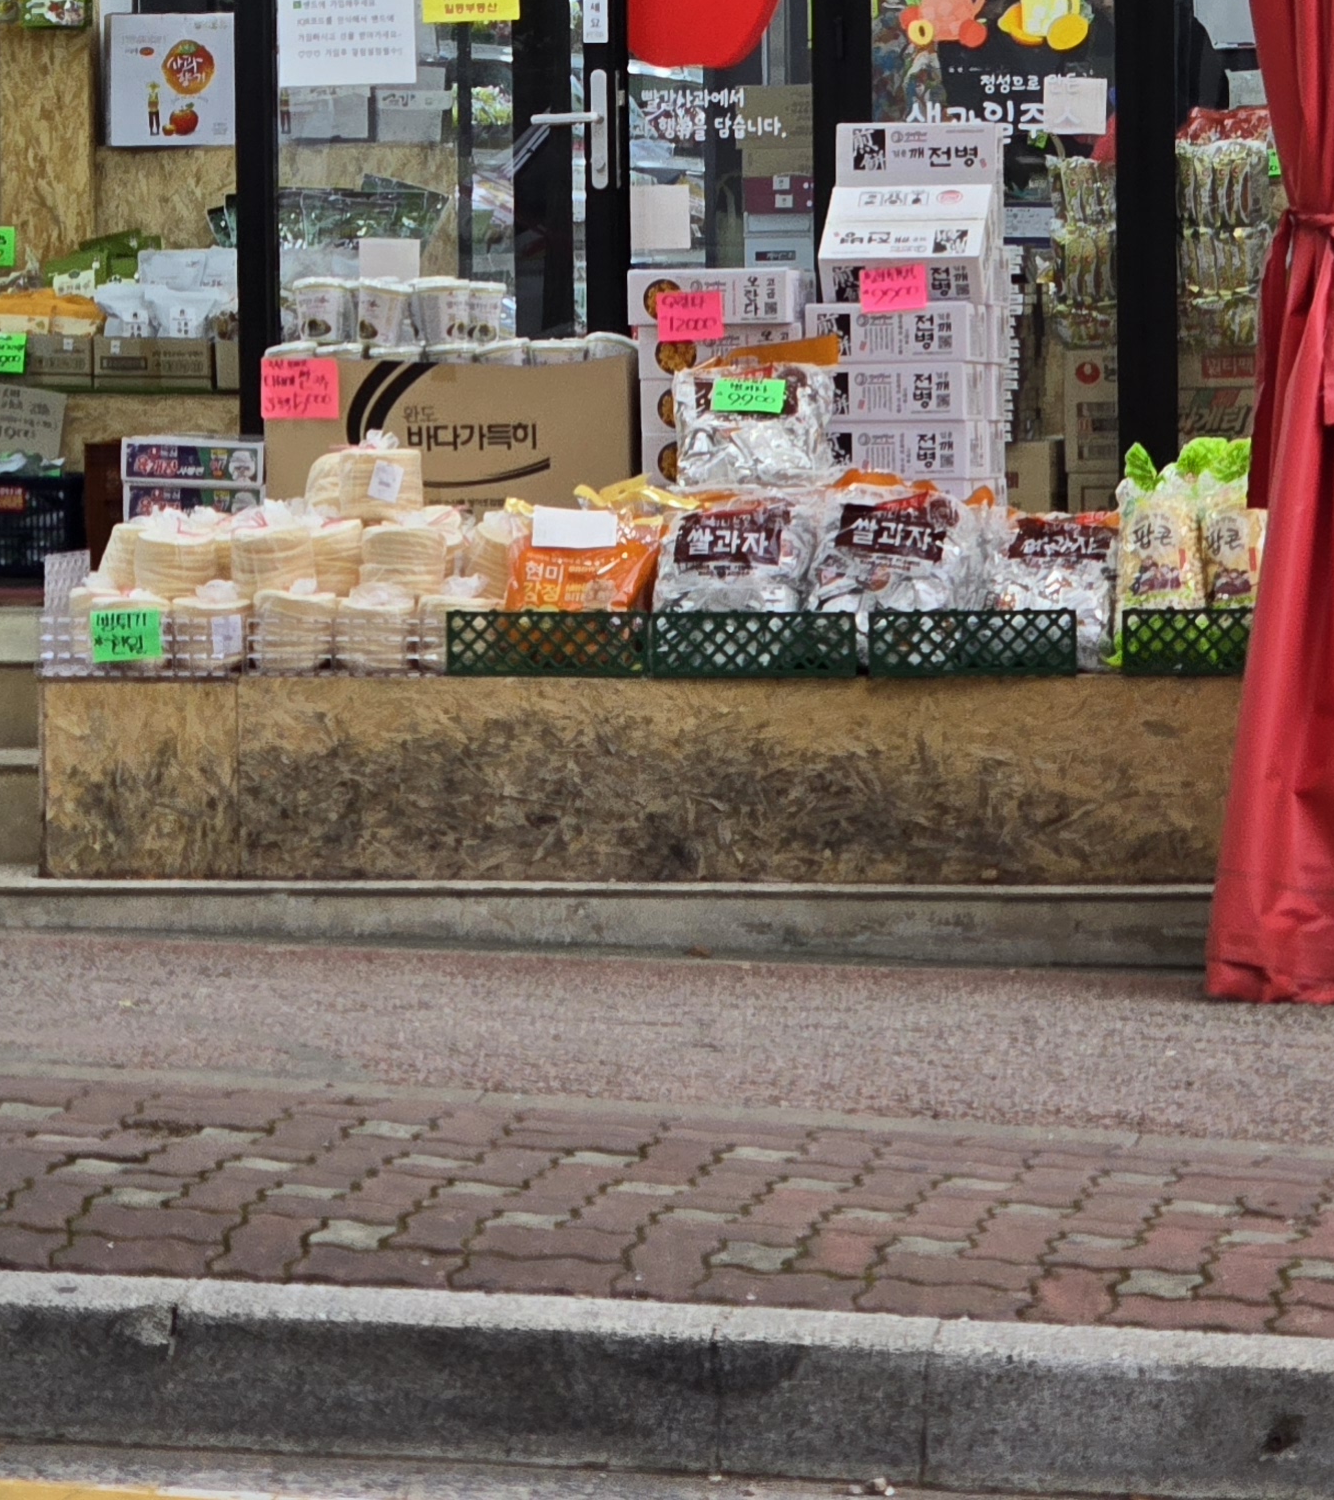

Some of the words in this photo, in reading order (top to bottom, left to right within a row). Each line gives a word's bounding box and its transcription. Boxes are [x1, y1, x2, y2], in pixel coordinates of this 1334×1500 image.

[980, 73, 1041, 94] 정성으로
[403, 404, 437, 424] 완도
[406, 422, 538, 452] 바다가득히
[686, 527, 770, 557] 쌀과자
[852, 516, 932, 552] 쌀과자
[1132, 523, 1173, 550] 팝콘
[524, 558, 564, 584] 현미
